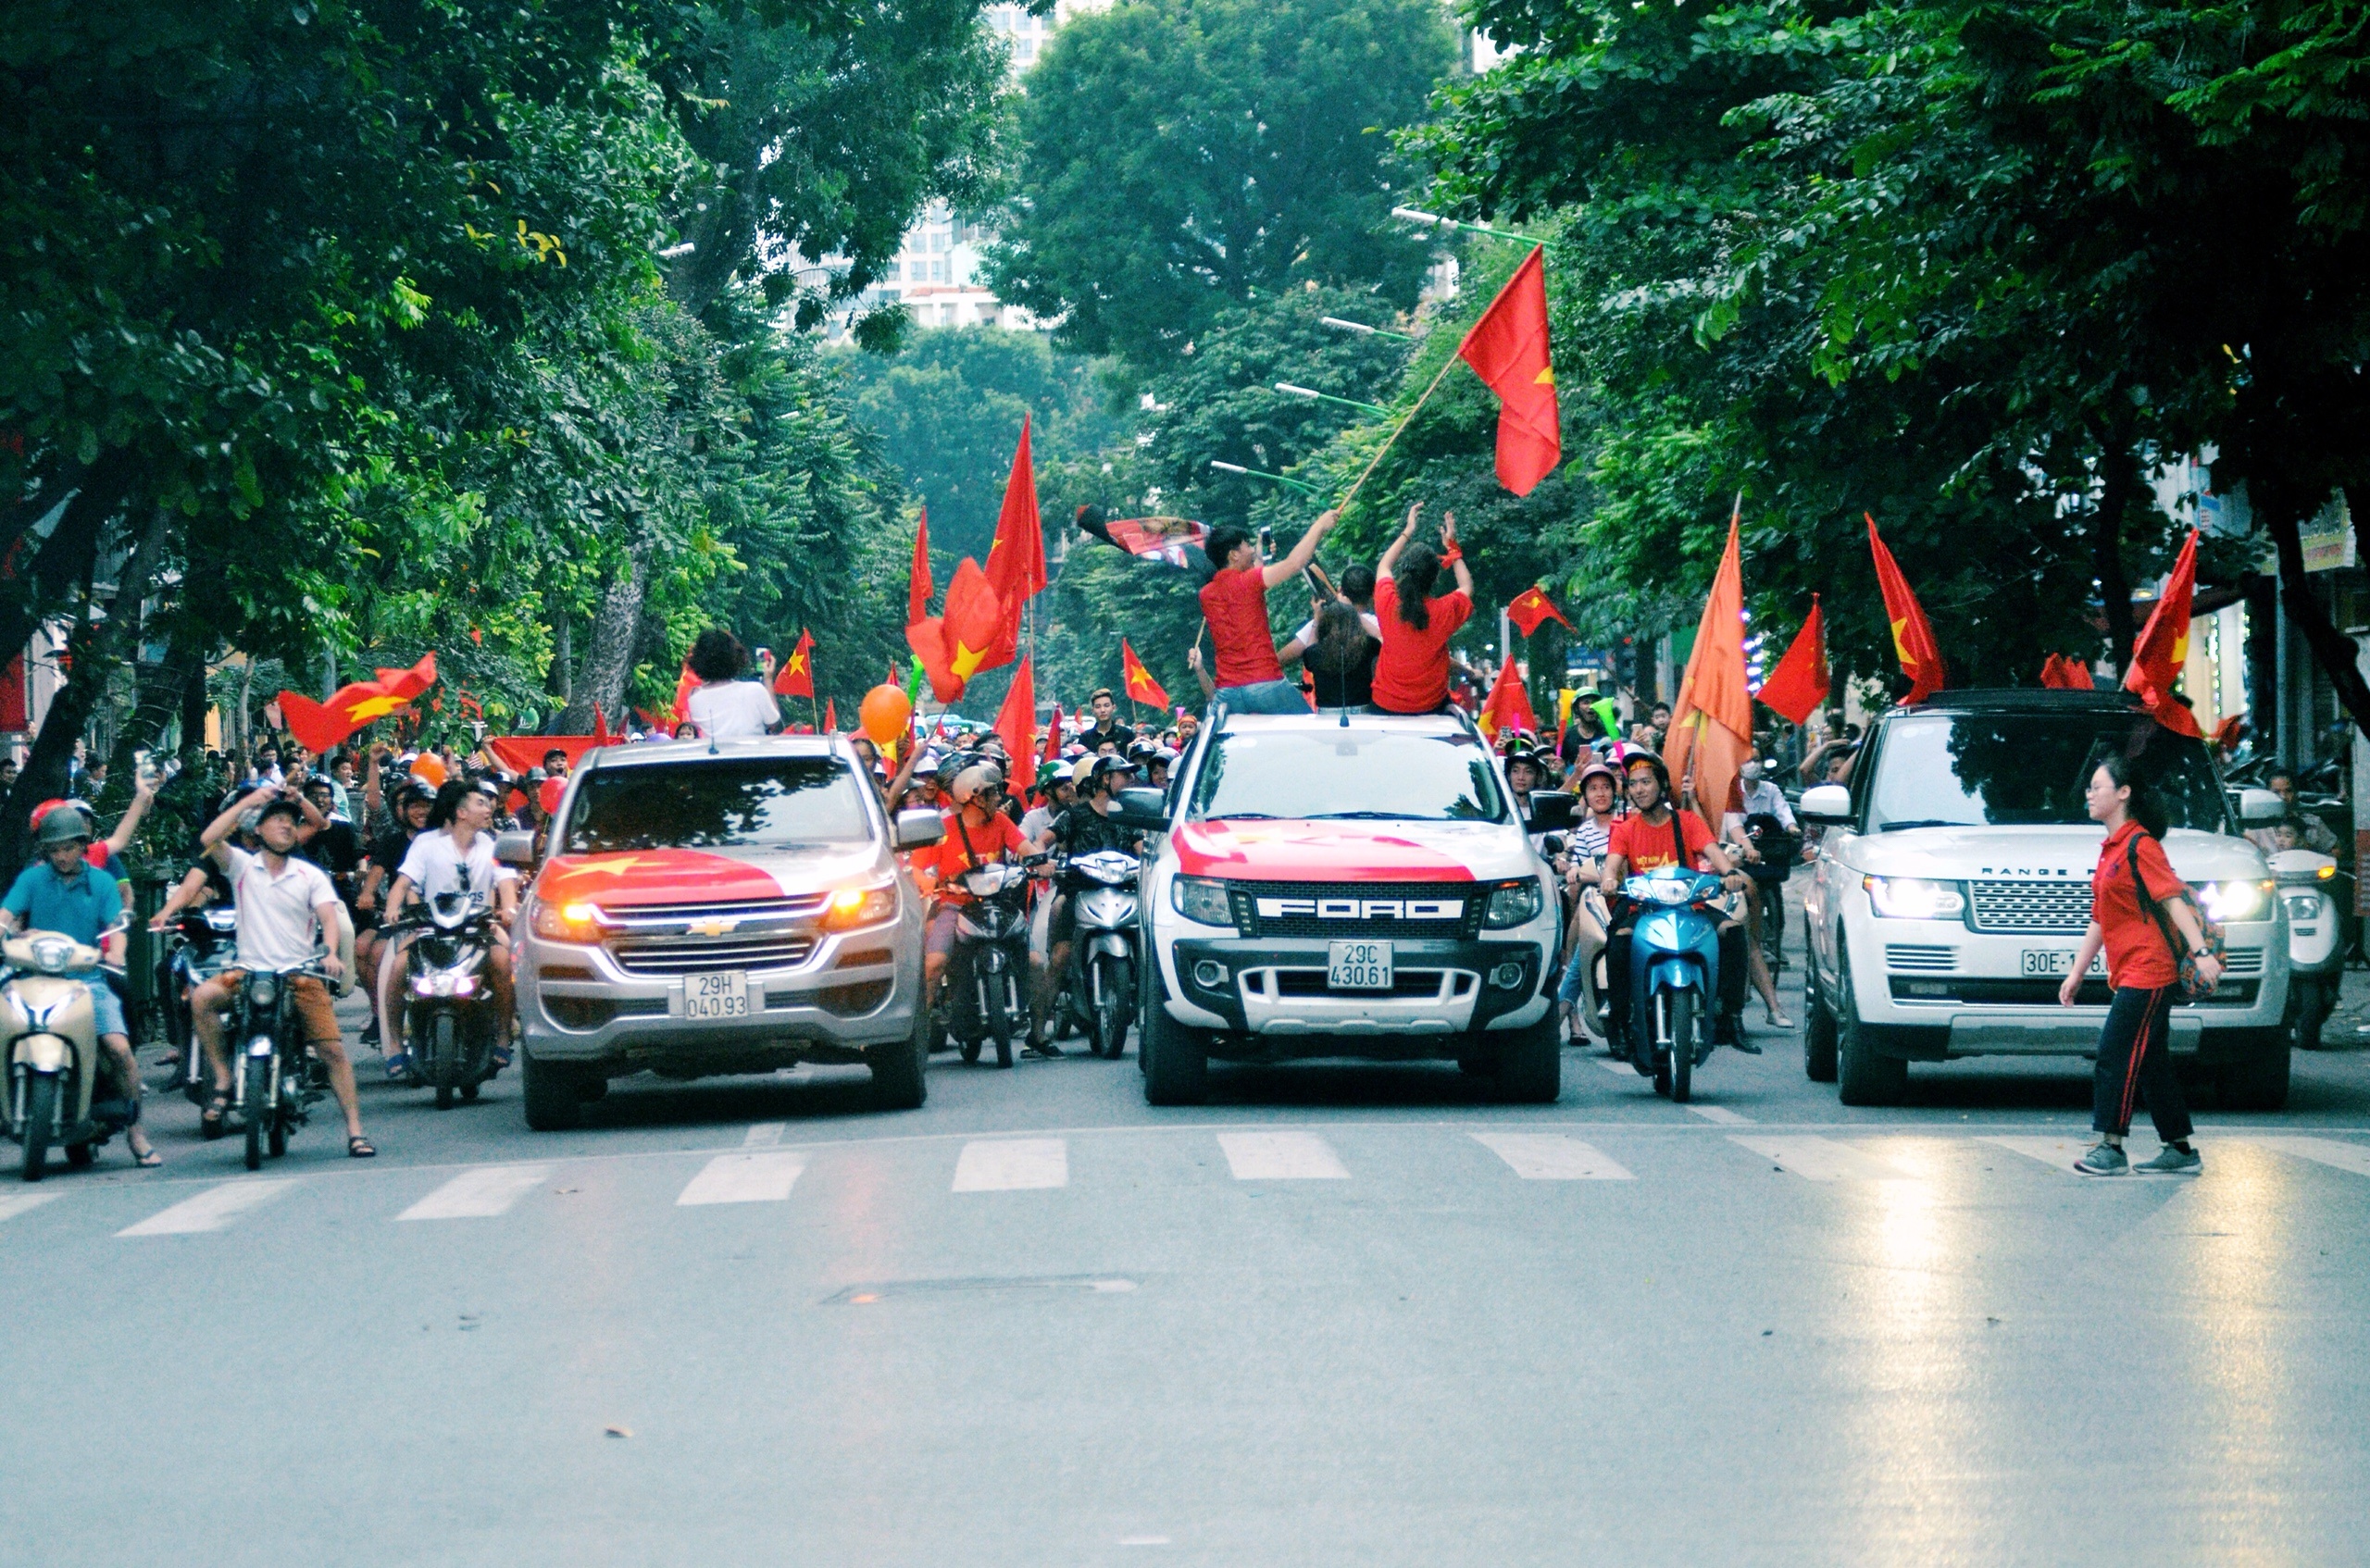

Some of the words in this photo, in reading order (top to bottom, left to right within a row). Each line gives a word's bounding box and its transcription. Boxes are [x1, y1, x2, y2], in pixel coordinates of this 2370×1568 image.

[1981, 866, 2068, 876] RANGE
[1256, 898, 1465, 919] FORD
[1343, 944, 1378, 964] 29C
[699, 975, 732, 996] 29H
[1330, 965, 1389, 986] 430.61
